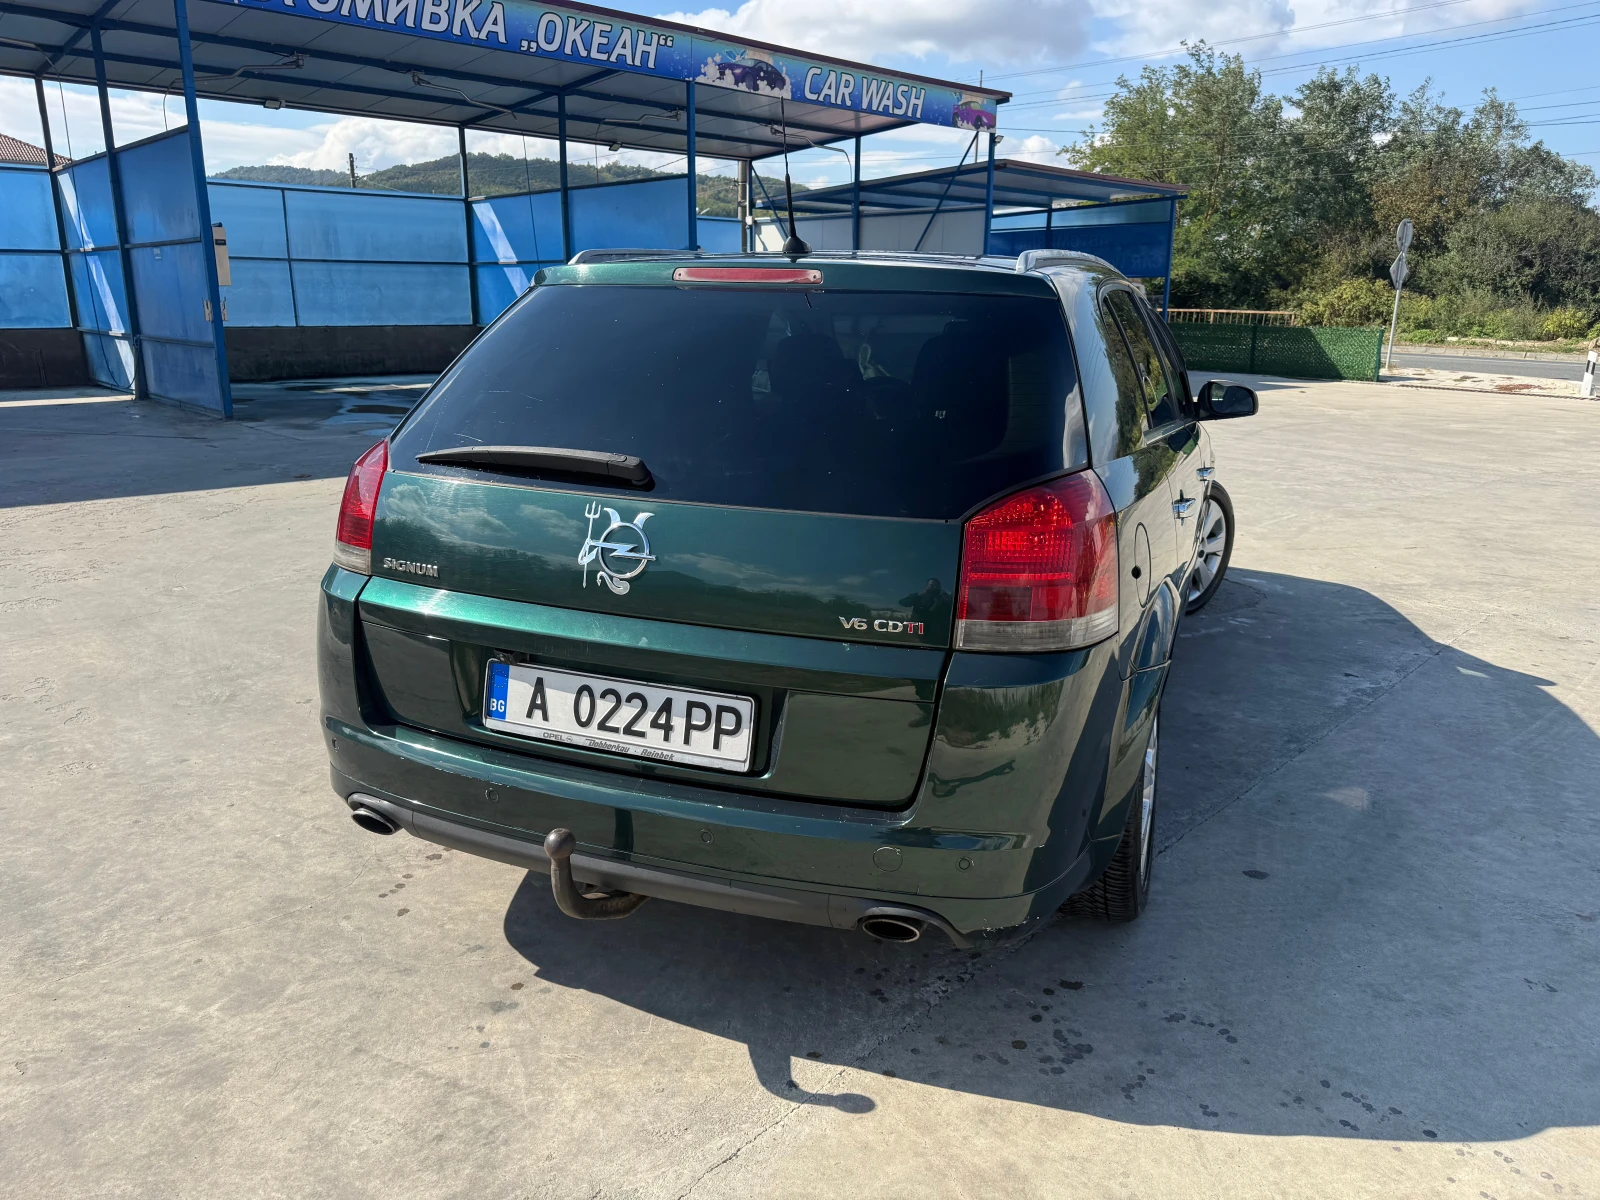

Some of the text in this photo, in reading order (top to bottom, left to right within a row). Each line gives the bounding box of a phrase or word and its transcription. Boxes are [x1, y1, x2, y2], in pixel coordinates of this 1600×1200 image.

[520, 11, 674, 69] „ОКЕАН“
[803, 66, 926, 119] CAR WASH
[383, 557, 438, 577] SIGNUM
[838, 615, 924, 634] V6 CDTI
[489, 698, 505, 713] BG
[525, 676, 549, 722] A
[543, 732, 564, 742] OPEL
